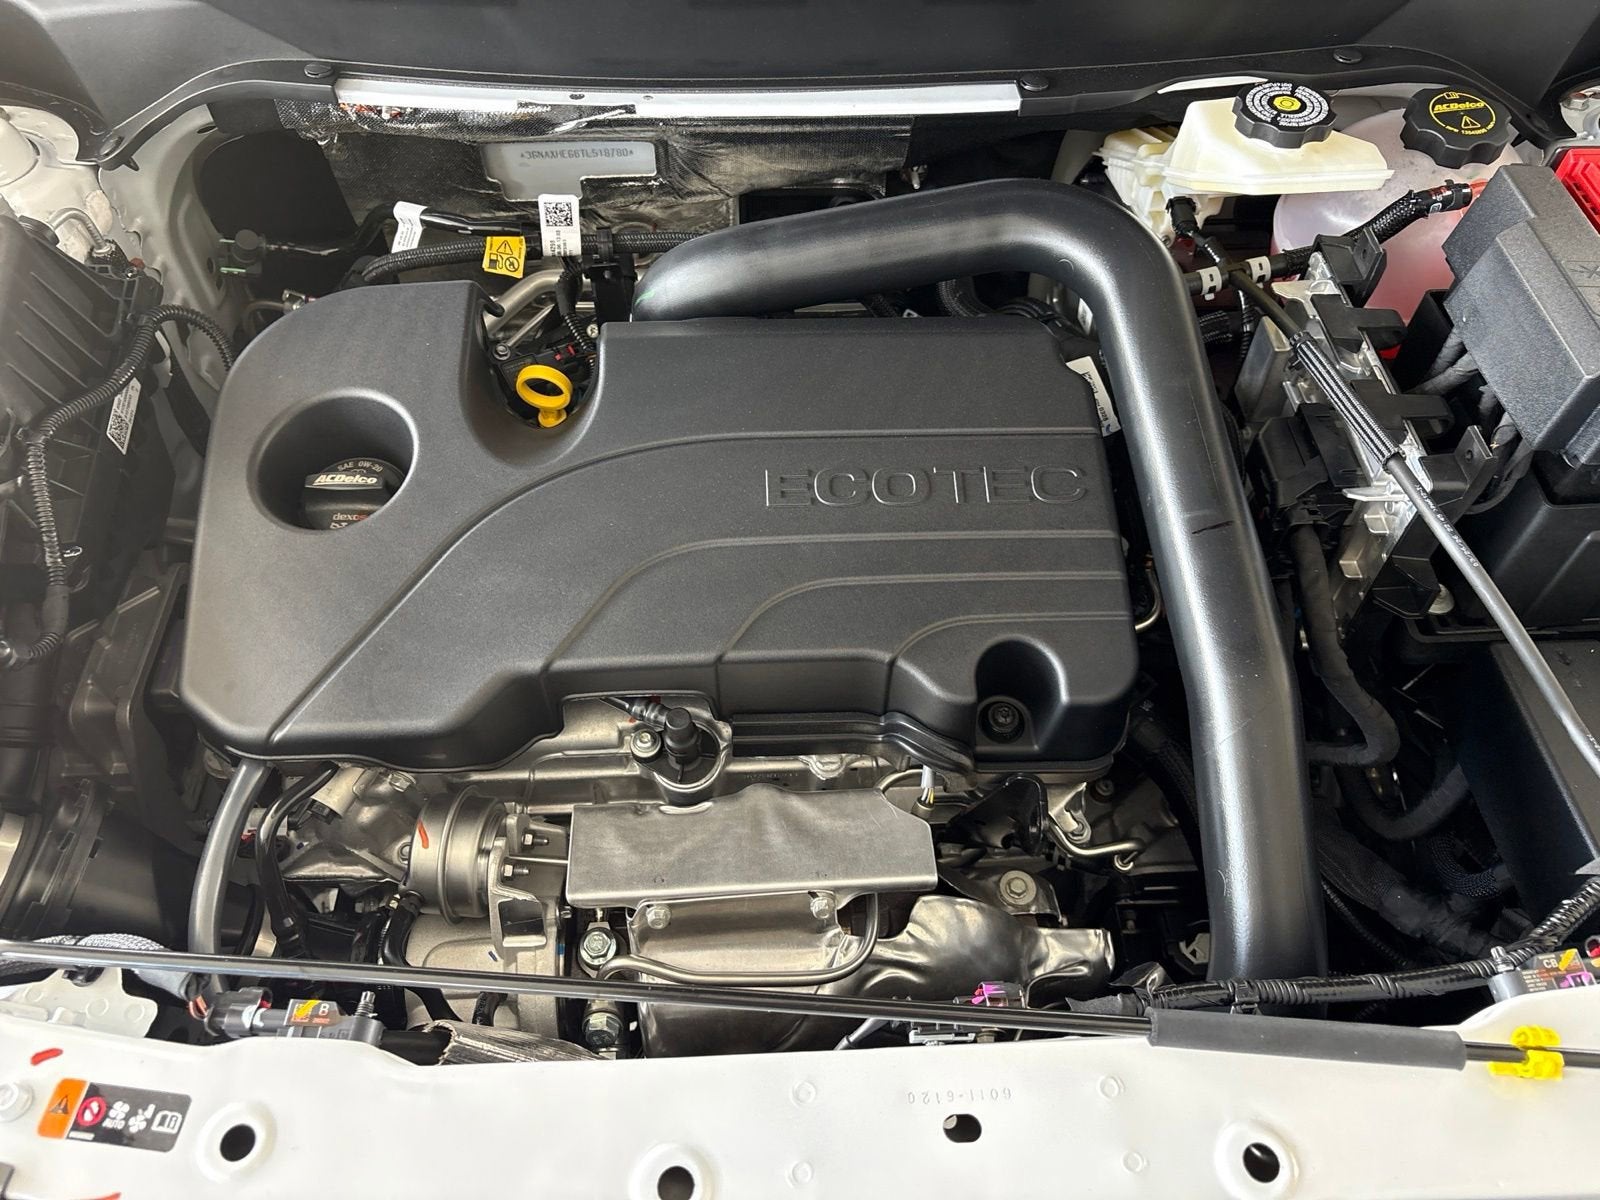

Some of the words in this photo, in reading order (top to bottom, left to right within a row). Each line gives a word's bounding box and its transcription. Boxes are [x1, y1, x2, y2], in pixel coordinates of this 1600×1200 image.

[1434, 102, 1485, 111] ACDelco
[337, 461, 354, 471] SAE
[358, 460, 384, 472] 0W-20
[313, 474, 378, 485] ACDelco
[763, 465, 1087, 506] ECOTEC
[102, 1117, 126, 1130] AUTO
